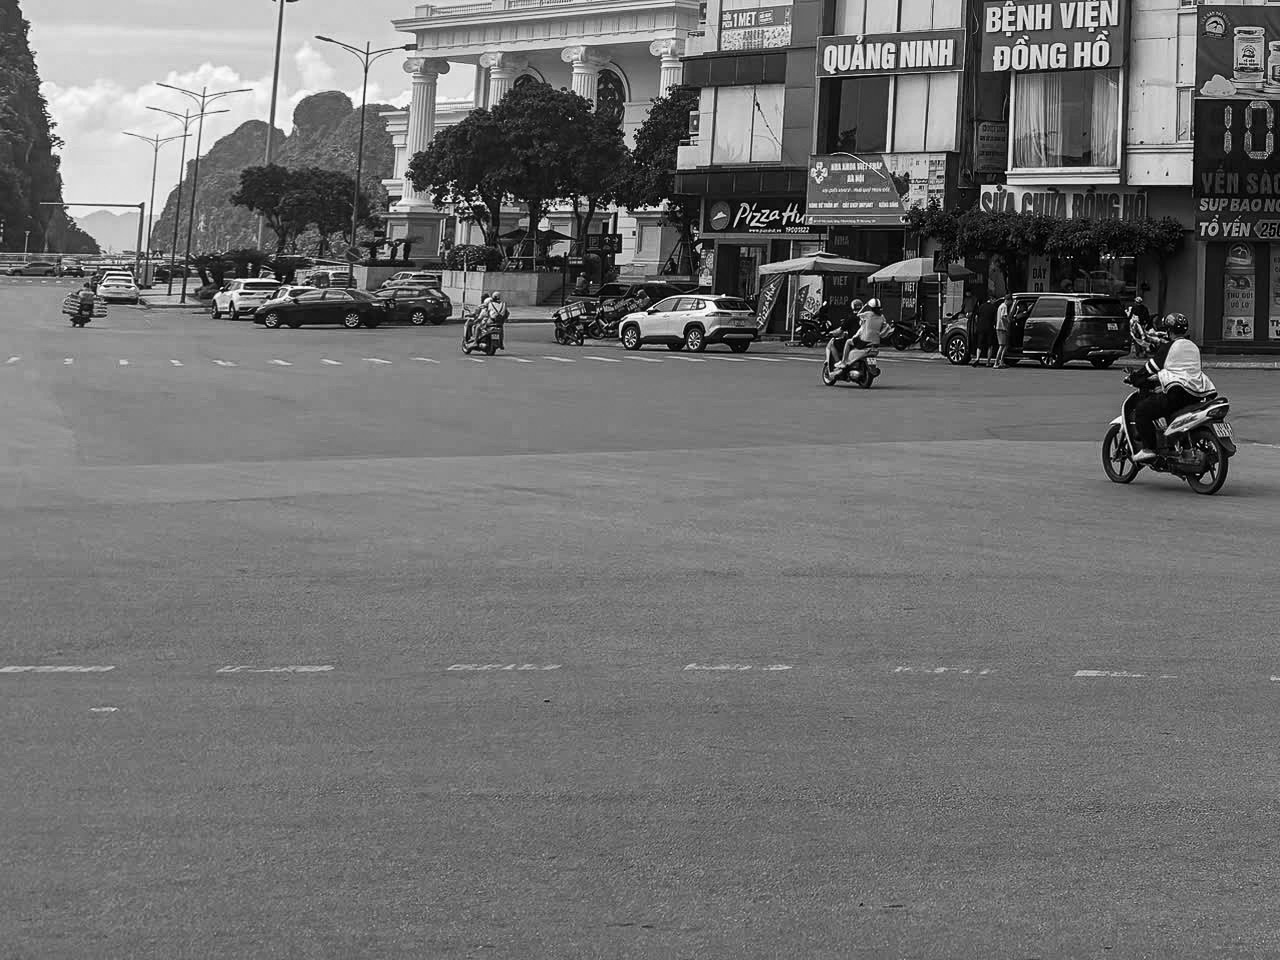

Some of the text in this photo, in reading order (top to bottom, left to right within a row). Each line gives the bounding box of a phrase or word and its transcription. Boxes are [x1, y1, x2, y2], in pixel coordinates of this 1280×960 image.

[985, 0, 1052, 37] BỆNH
[823, 35, 955, 72] QUẢNG NINH
[992, 30, 1110, 71] ĐỒNG HỒ
[733, 202, 806, 228] Pizza Hu
[1222, 215, 1251, 237] YẾN
